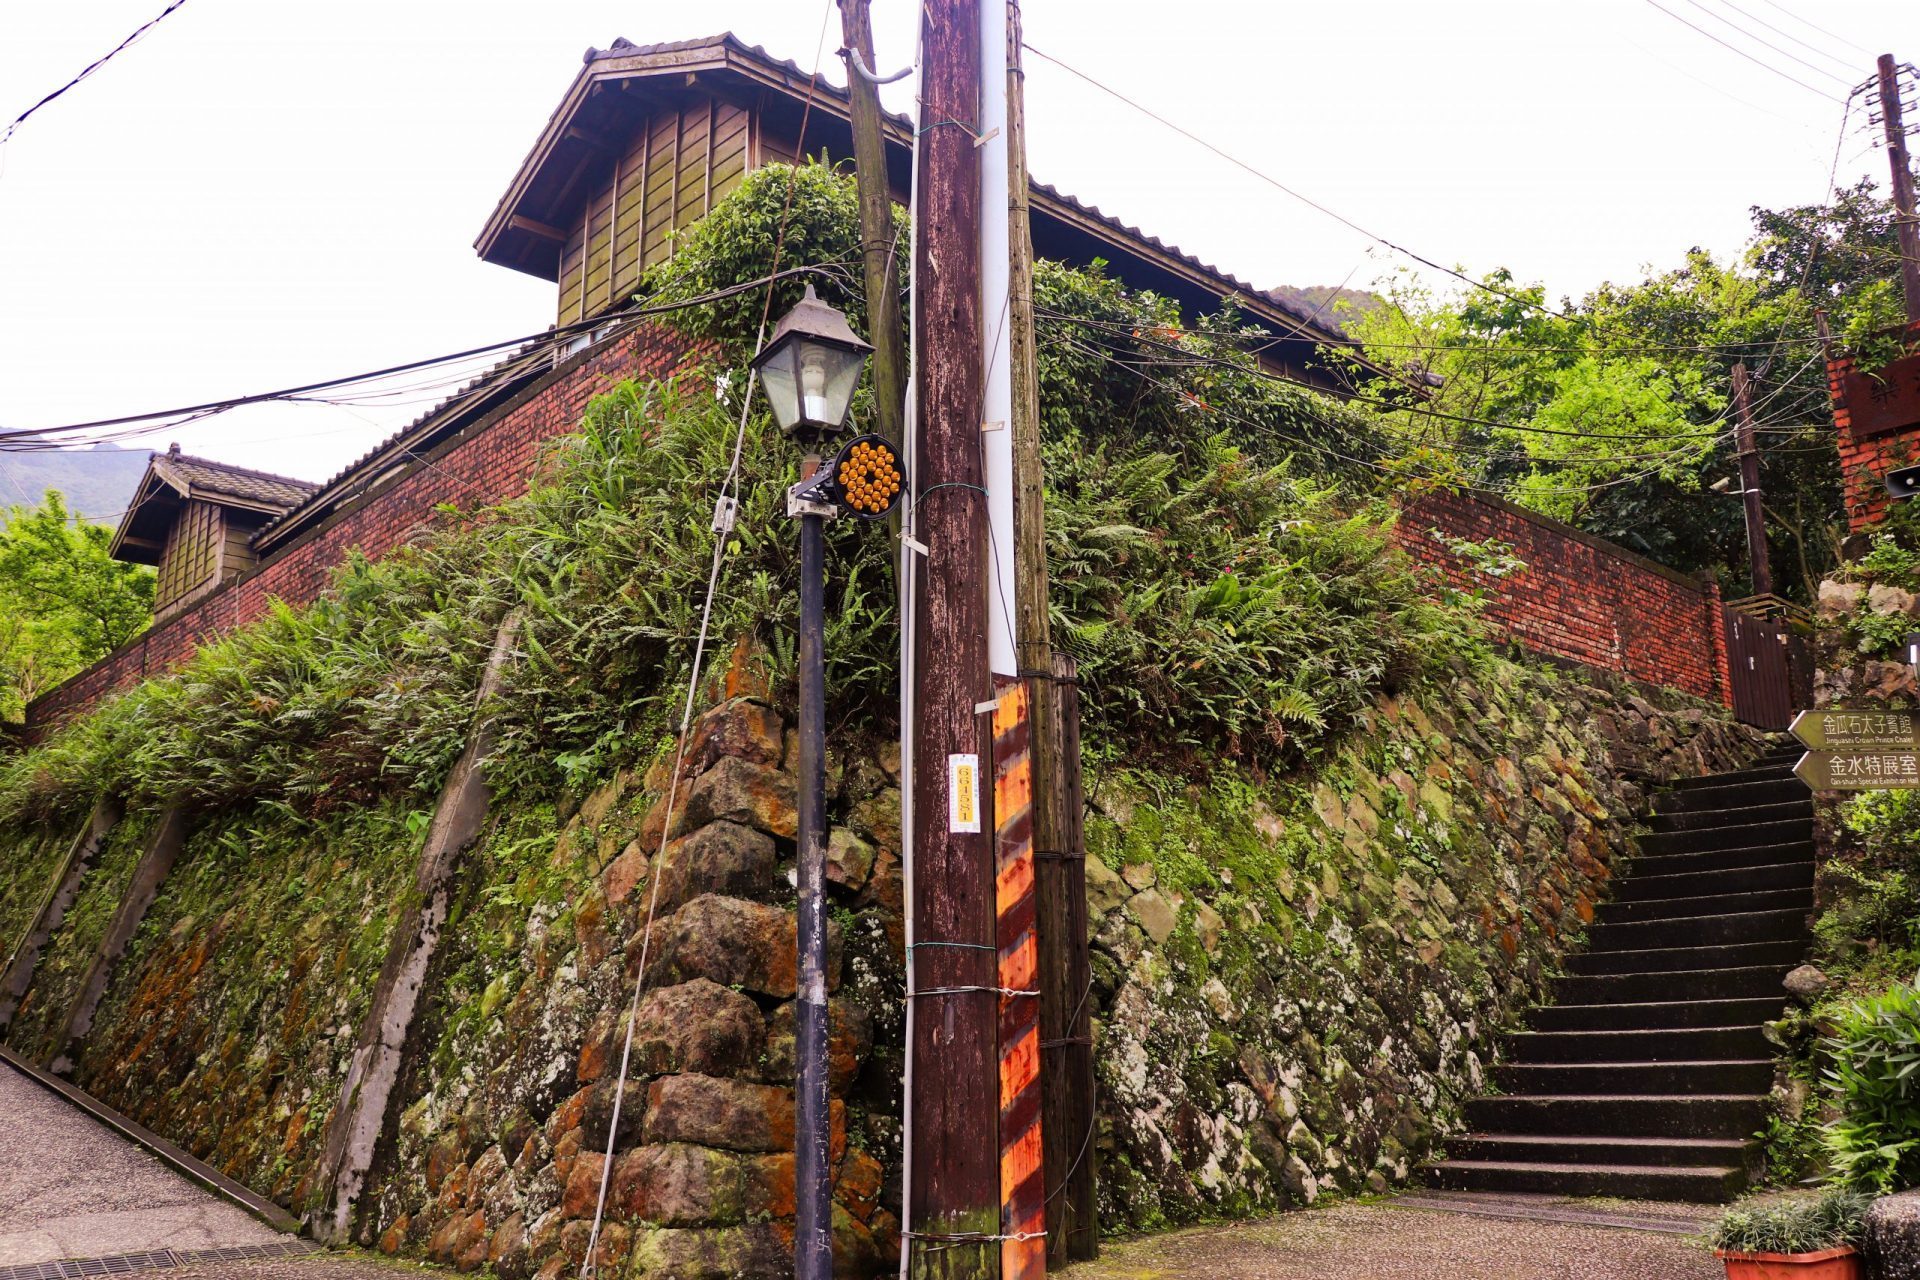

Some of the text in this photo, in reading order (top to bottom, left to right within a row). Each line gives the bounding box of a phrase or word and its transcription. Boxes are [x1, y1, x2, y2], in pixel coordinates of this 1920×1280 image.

[1823, 714, 1913, 735] 金瓜石太子賓館
[1826, 736, 1914, 746] Jinguashi Crown Prince Chalet
[1829, 754, 1918, 776] 金水特展室
[1858, 777, 1879, 786] Special
[1879, 777, 1907, 785] Exhibition
